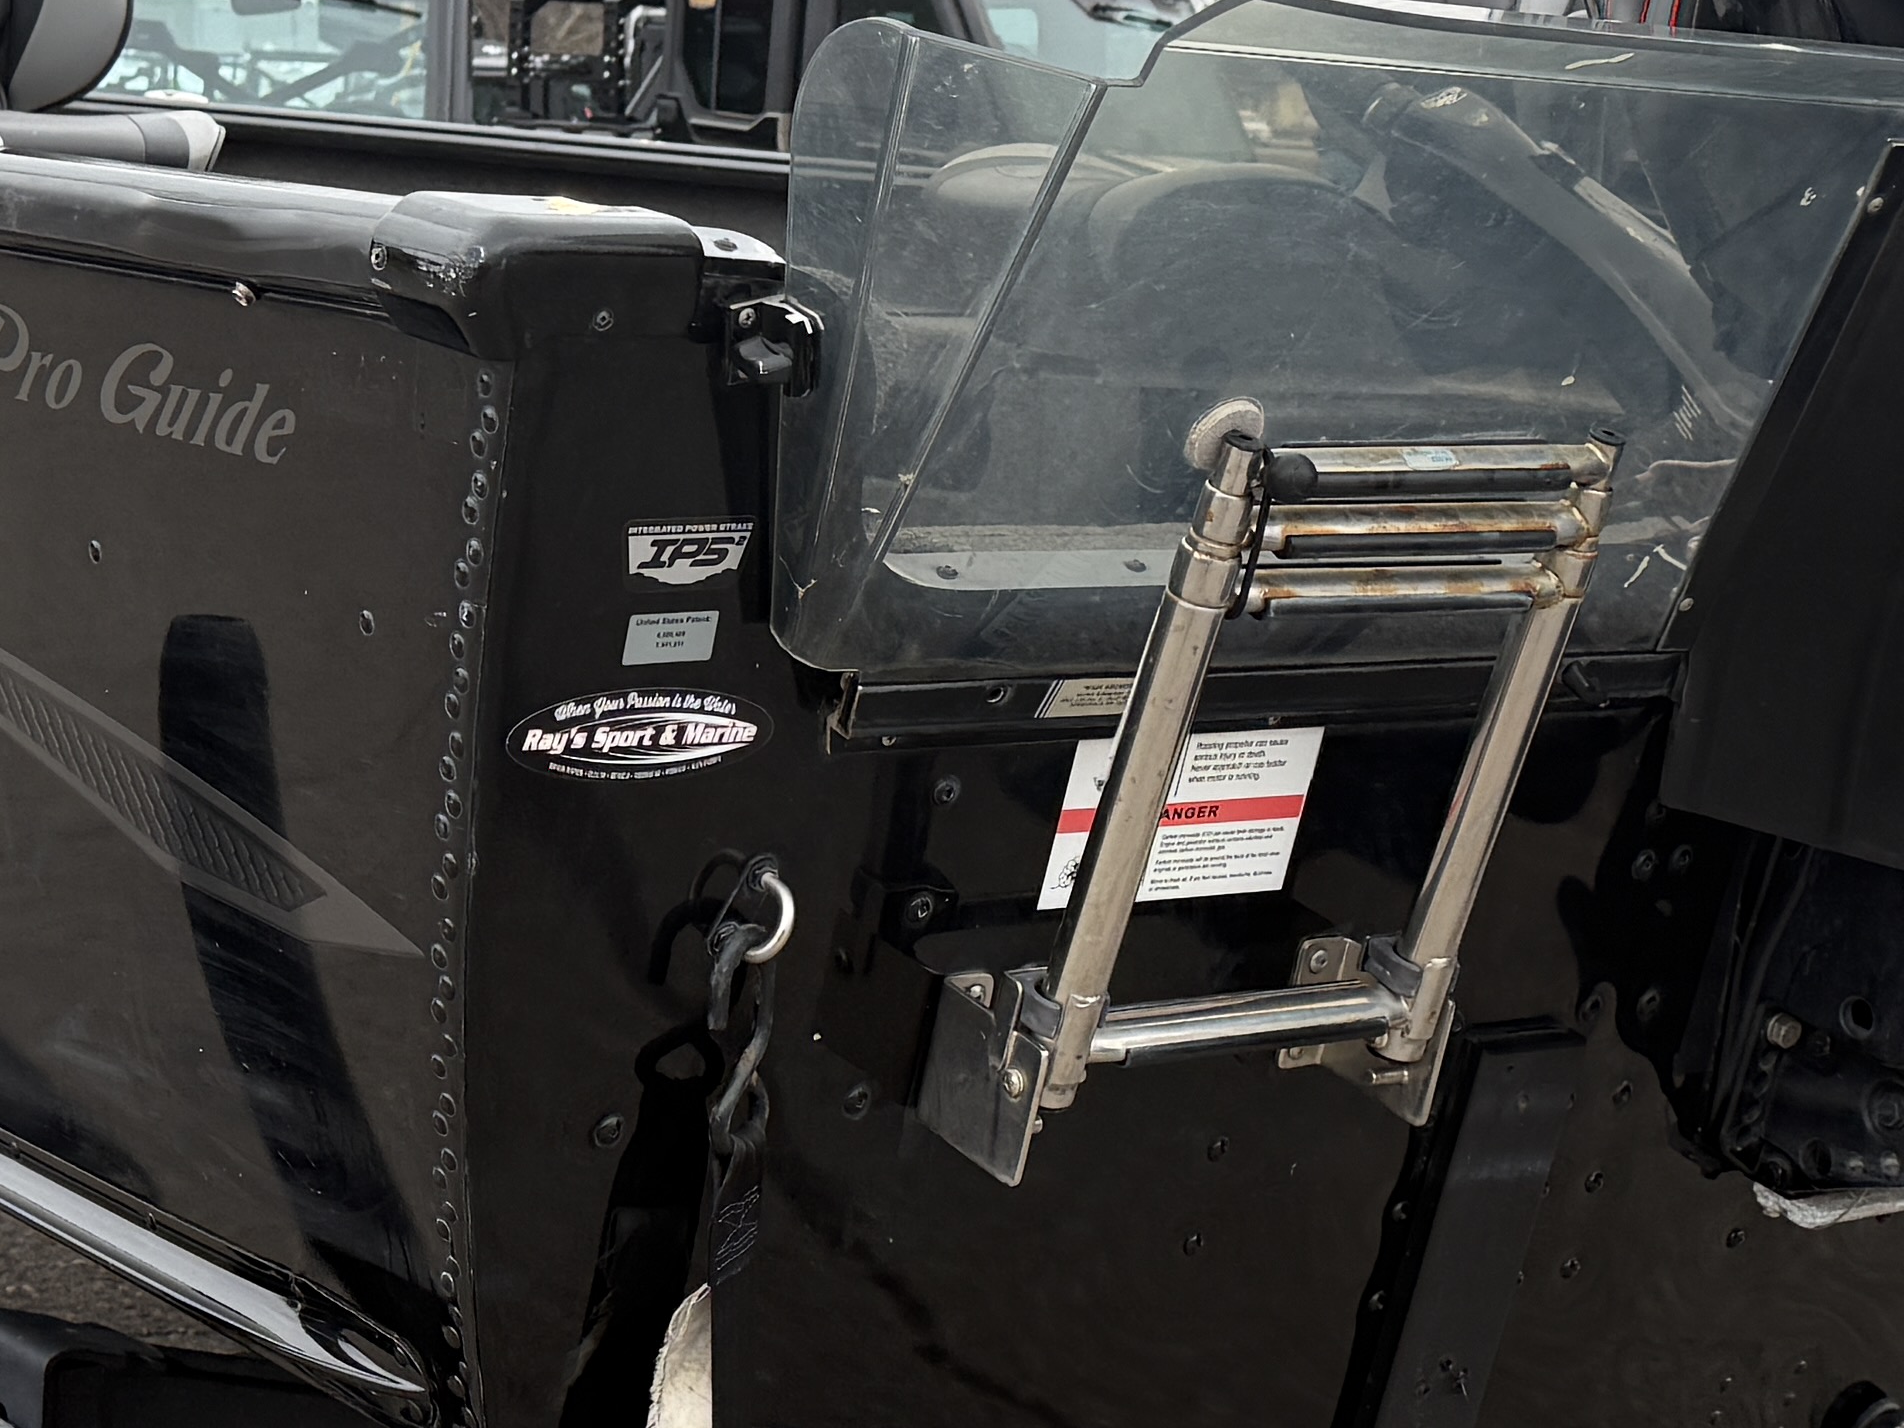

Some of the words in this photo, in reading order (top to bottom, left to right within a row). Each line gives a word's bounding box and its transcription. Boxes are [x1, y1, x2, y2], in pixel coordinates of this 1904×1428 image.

[100, 342, 296, 465] Guide
[554, 702, 591, 721] When
[593, 697, 625, 719] Your
[626, 692, 671, 710] Passion
[522, 725, 588, 755] Ray's
[591, 726, 655, 752] Sport
[658, 724, 680, 746] &
[681, 721, 758, 745] Marine
[1160, 805, 1220, 821] ANGER
